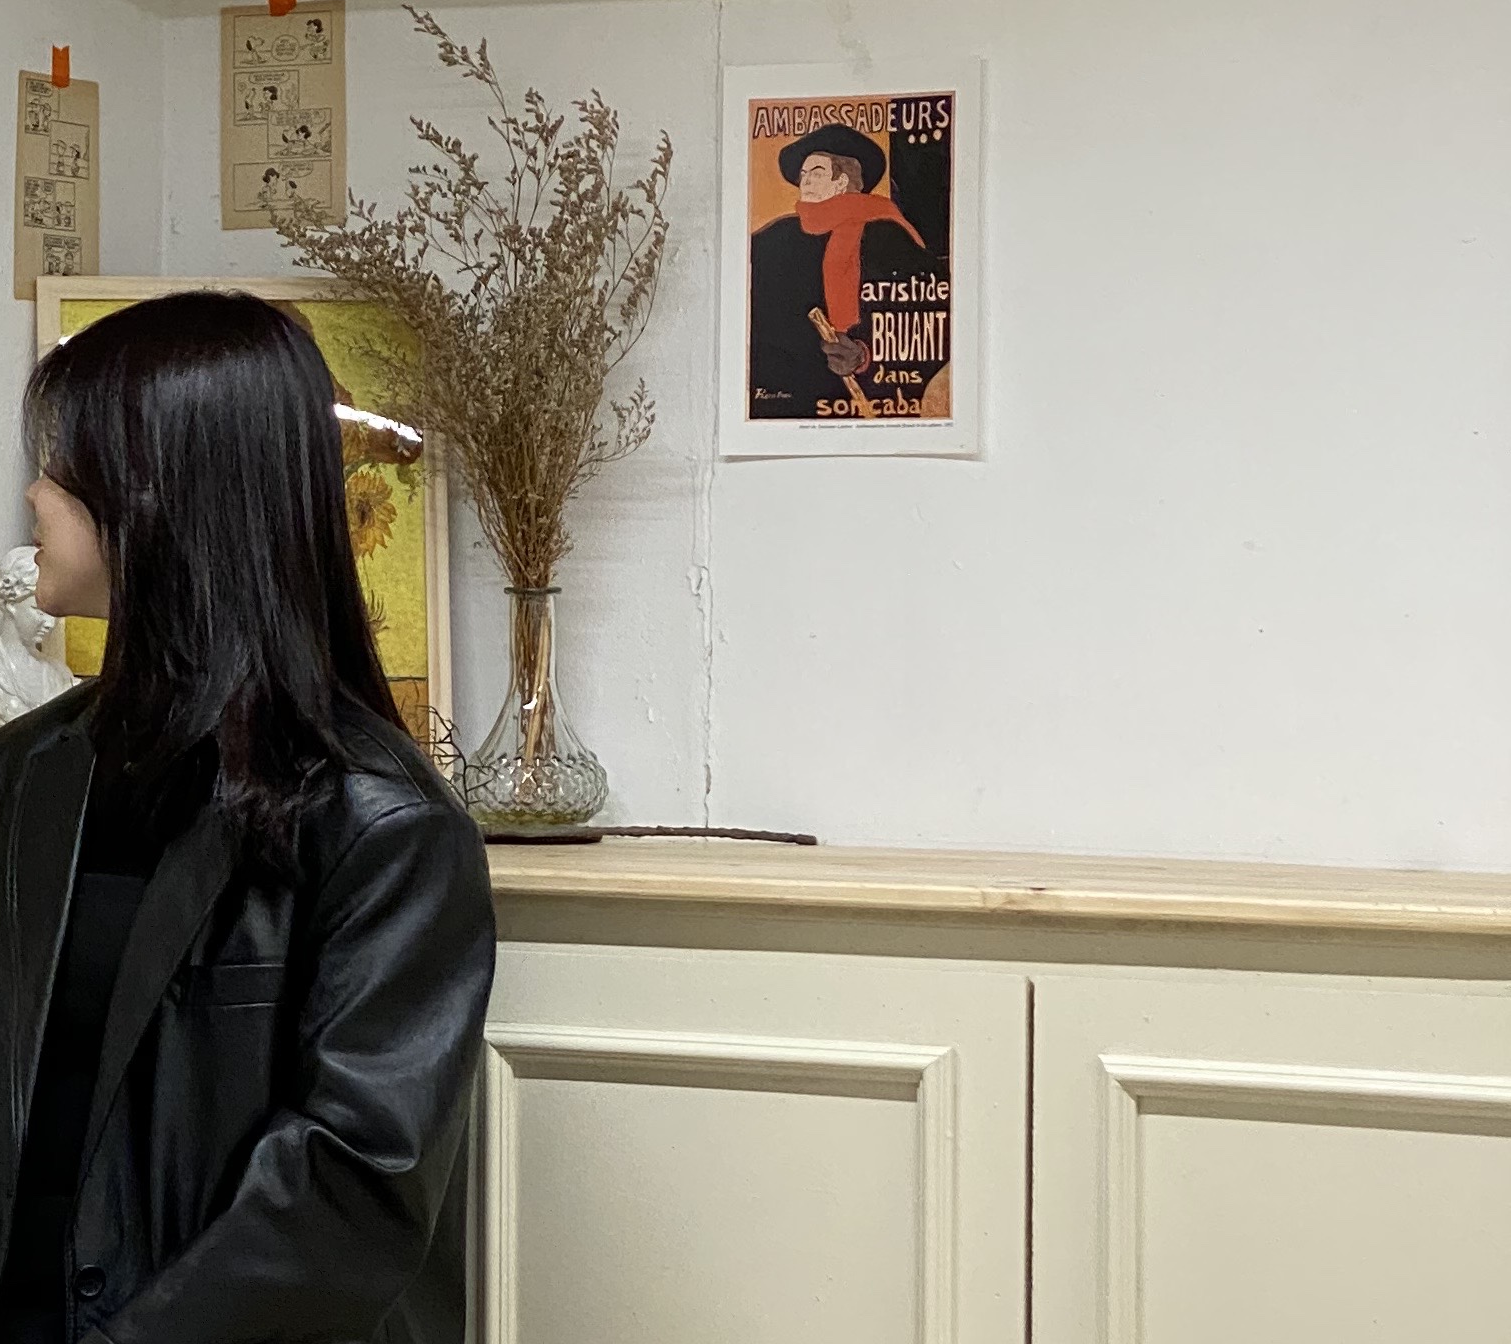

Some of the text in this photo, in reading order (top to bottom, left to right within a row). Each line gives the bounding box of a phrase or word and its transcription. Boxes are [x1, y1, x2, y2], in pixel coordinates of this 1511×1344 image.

[753, 99, 950, 139] AMBASSADEURS
[860, 271, 950, 303] aristide
[871, 310, 948, 363] BRUANT
[873, 366, 923, 385] dans
